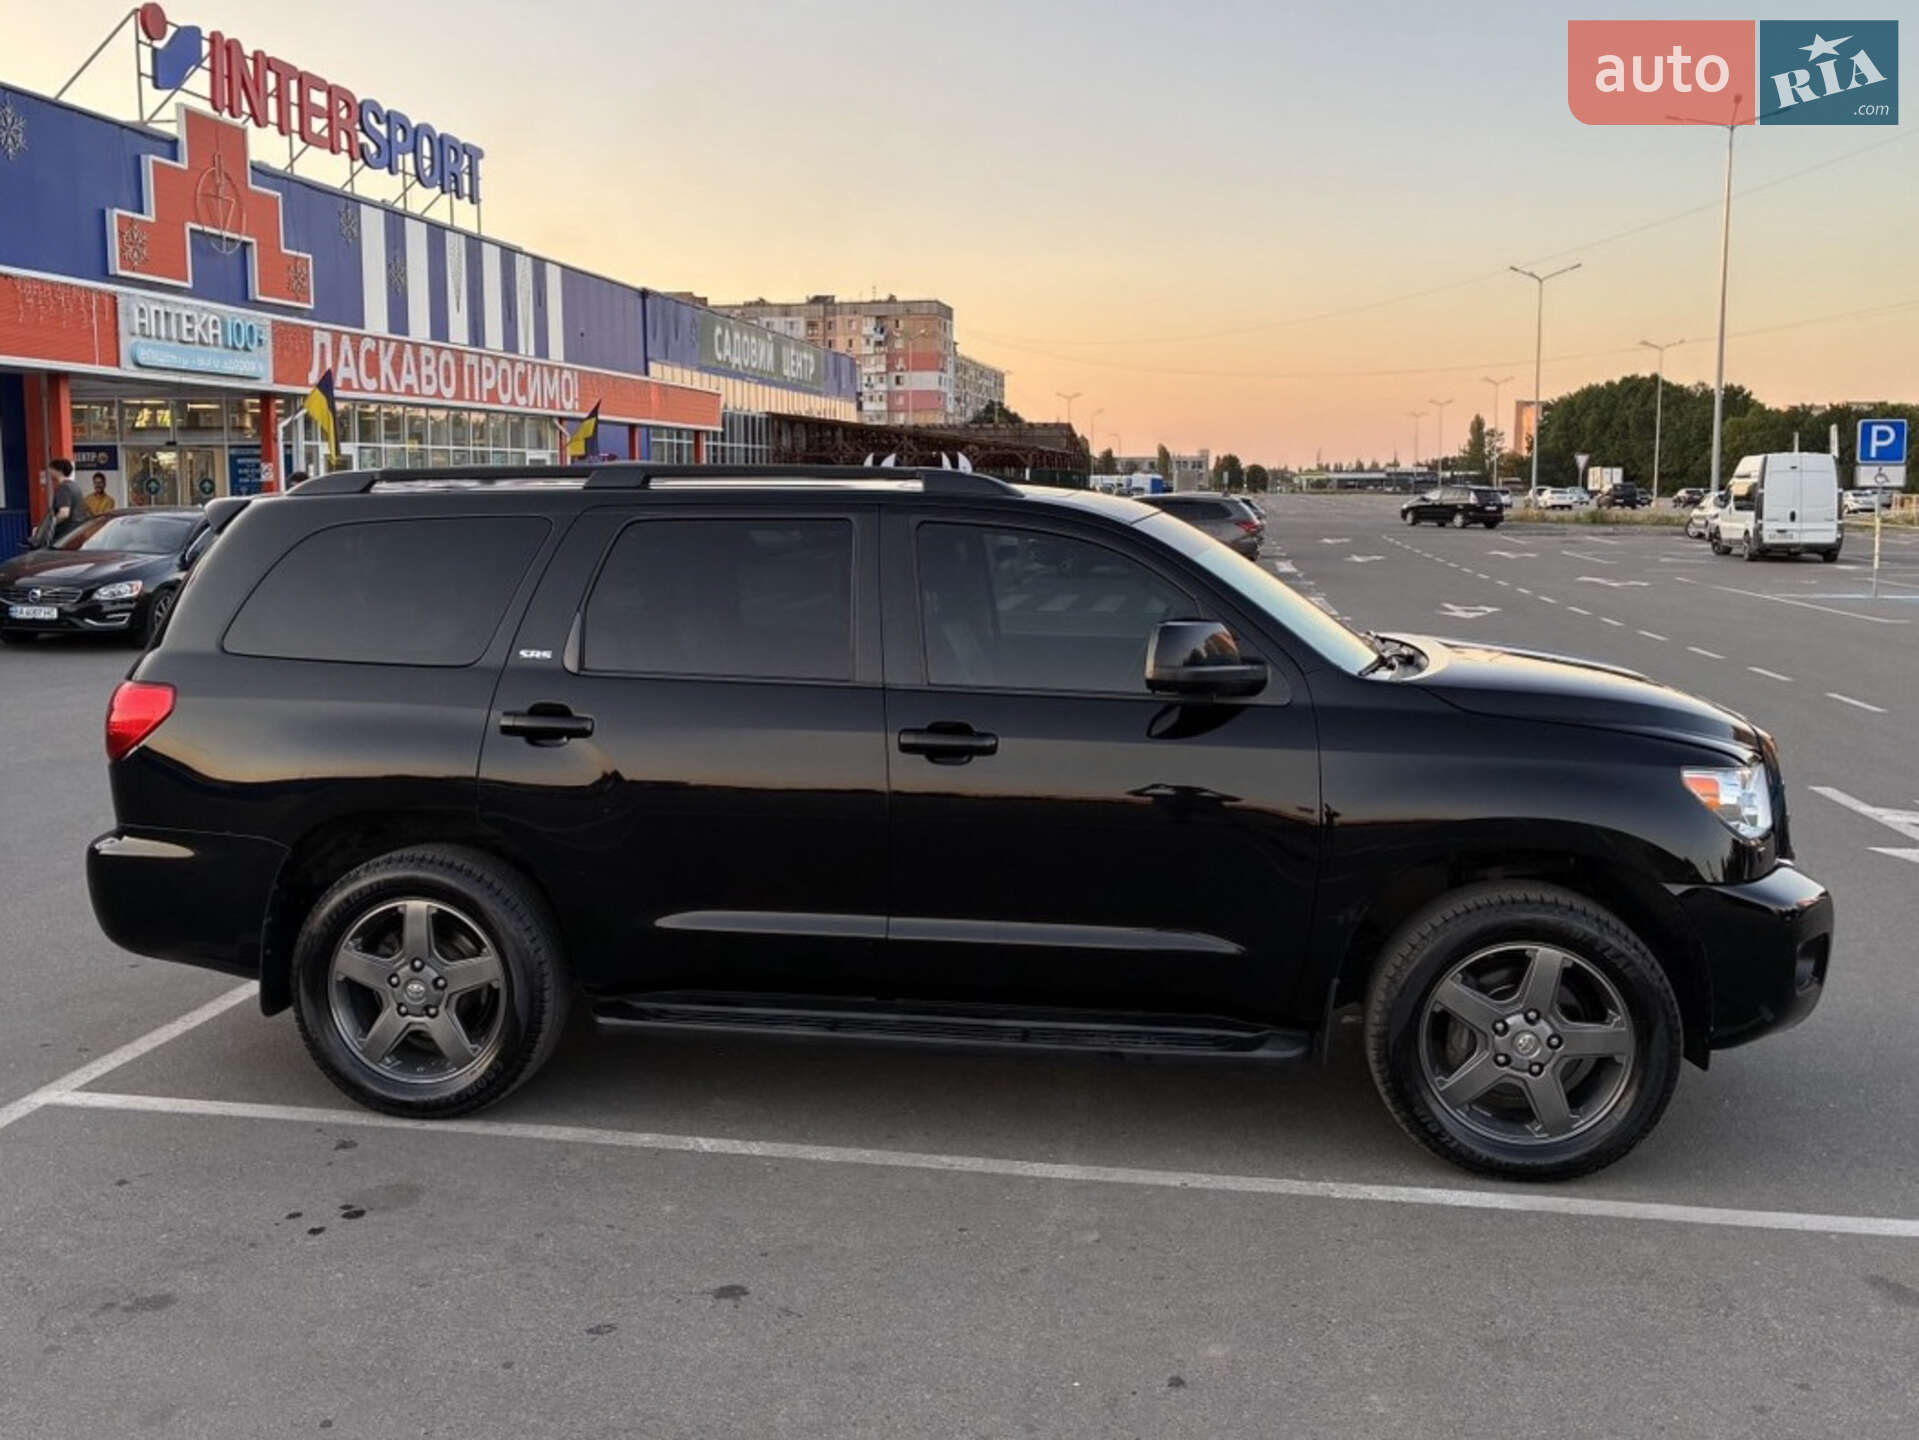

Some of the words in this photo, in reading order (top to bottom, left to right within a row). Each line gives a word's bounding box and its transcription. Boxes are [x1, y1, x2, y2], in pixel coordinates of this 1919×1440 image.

[209, 30, 484, 204] INTERSPORT
[133, 303, 222, 346] АПТЕКА
[308, 329, 456, 398] ЛАСКАВО
[463, 353, 580, 411] ПРОСИМО!
[713, 325, 775, 374] САДОВИЙ
[782, 345, 815, 379] ЦЕНТР
[1869, 424, 1896, 458] P
